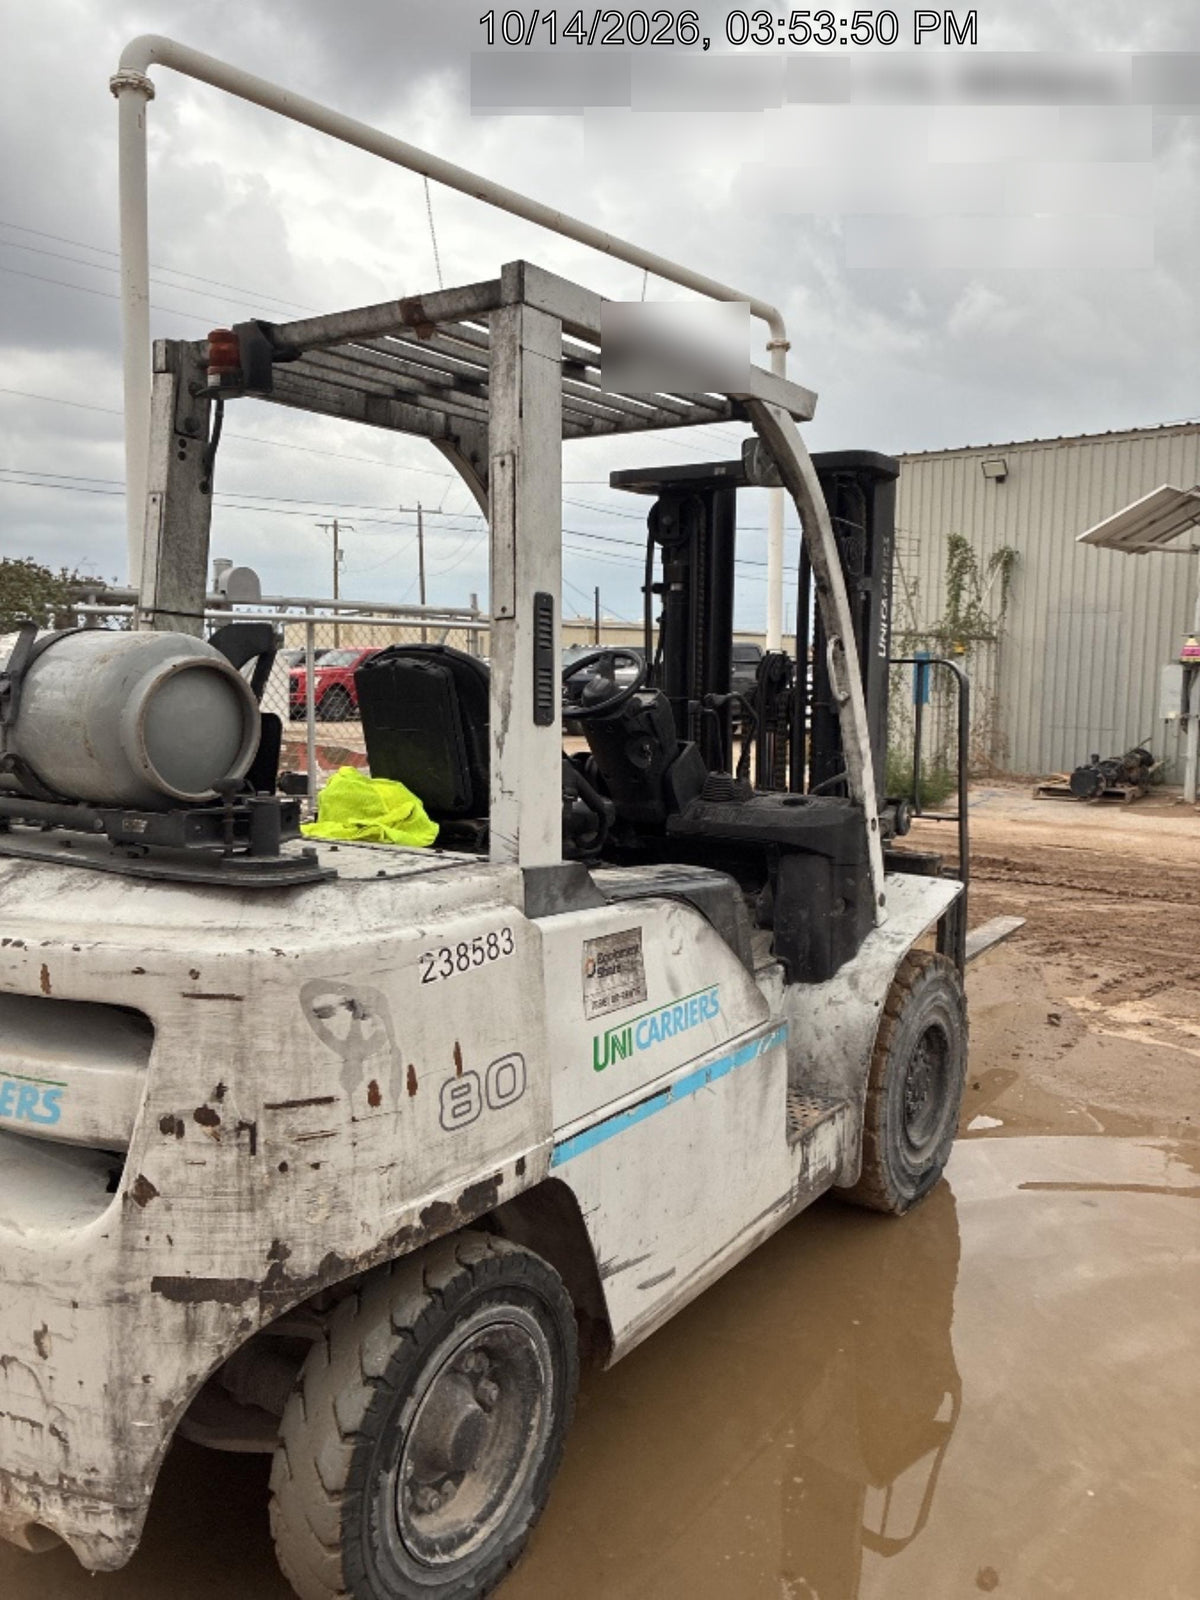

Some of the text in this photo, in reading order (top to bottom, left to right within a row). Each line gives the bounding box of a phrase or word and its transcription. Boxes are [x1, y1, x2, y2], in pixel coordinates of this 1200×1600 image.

[419, 927, 515, 984] 238583
[593, 986, 720, 1072] UNICARRIERS
[439, 1051, 527, 1132] 80
